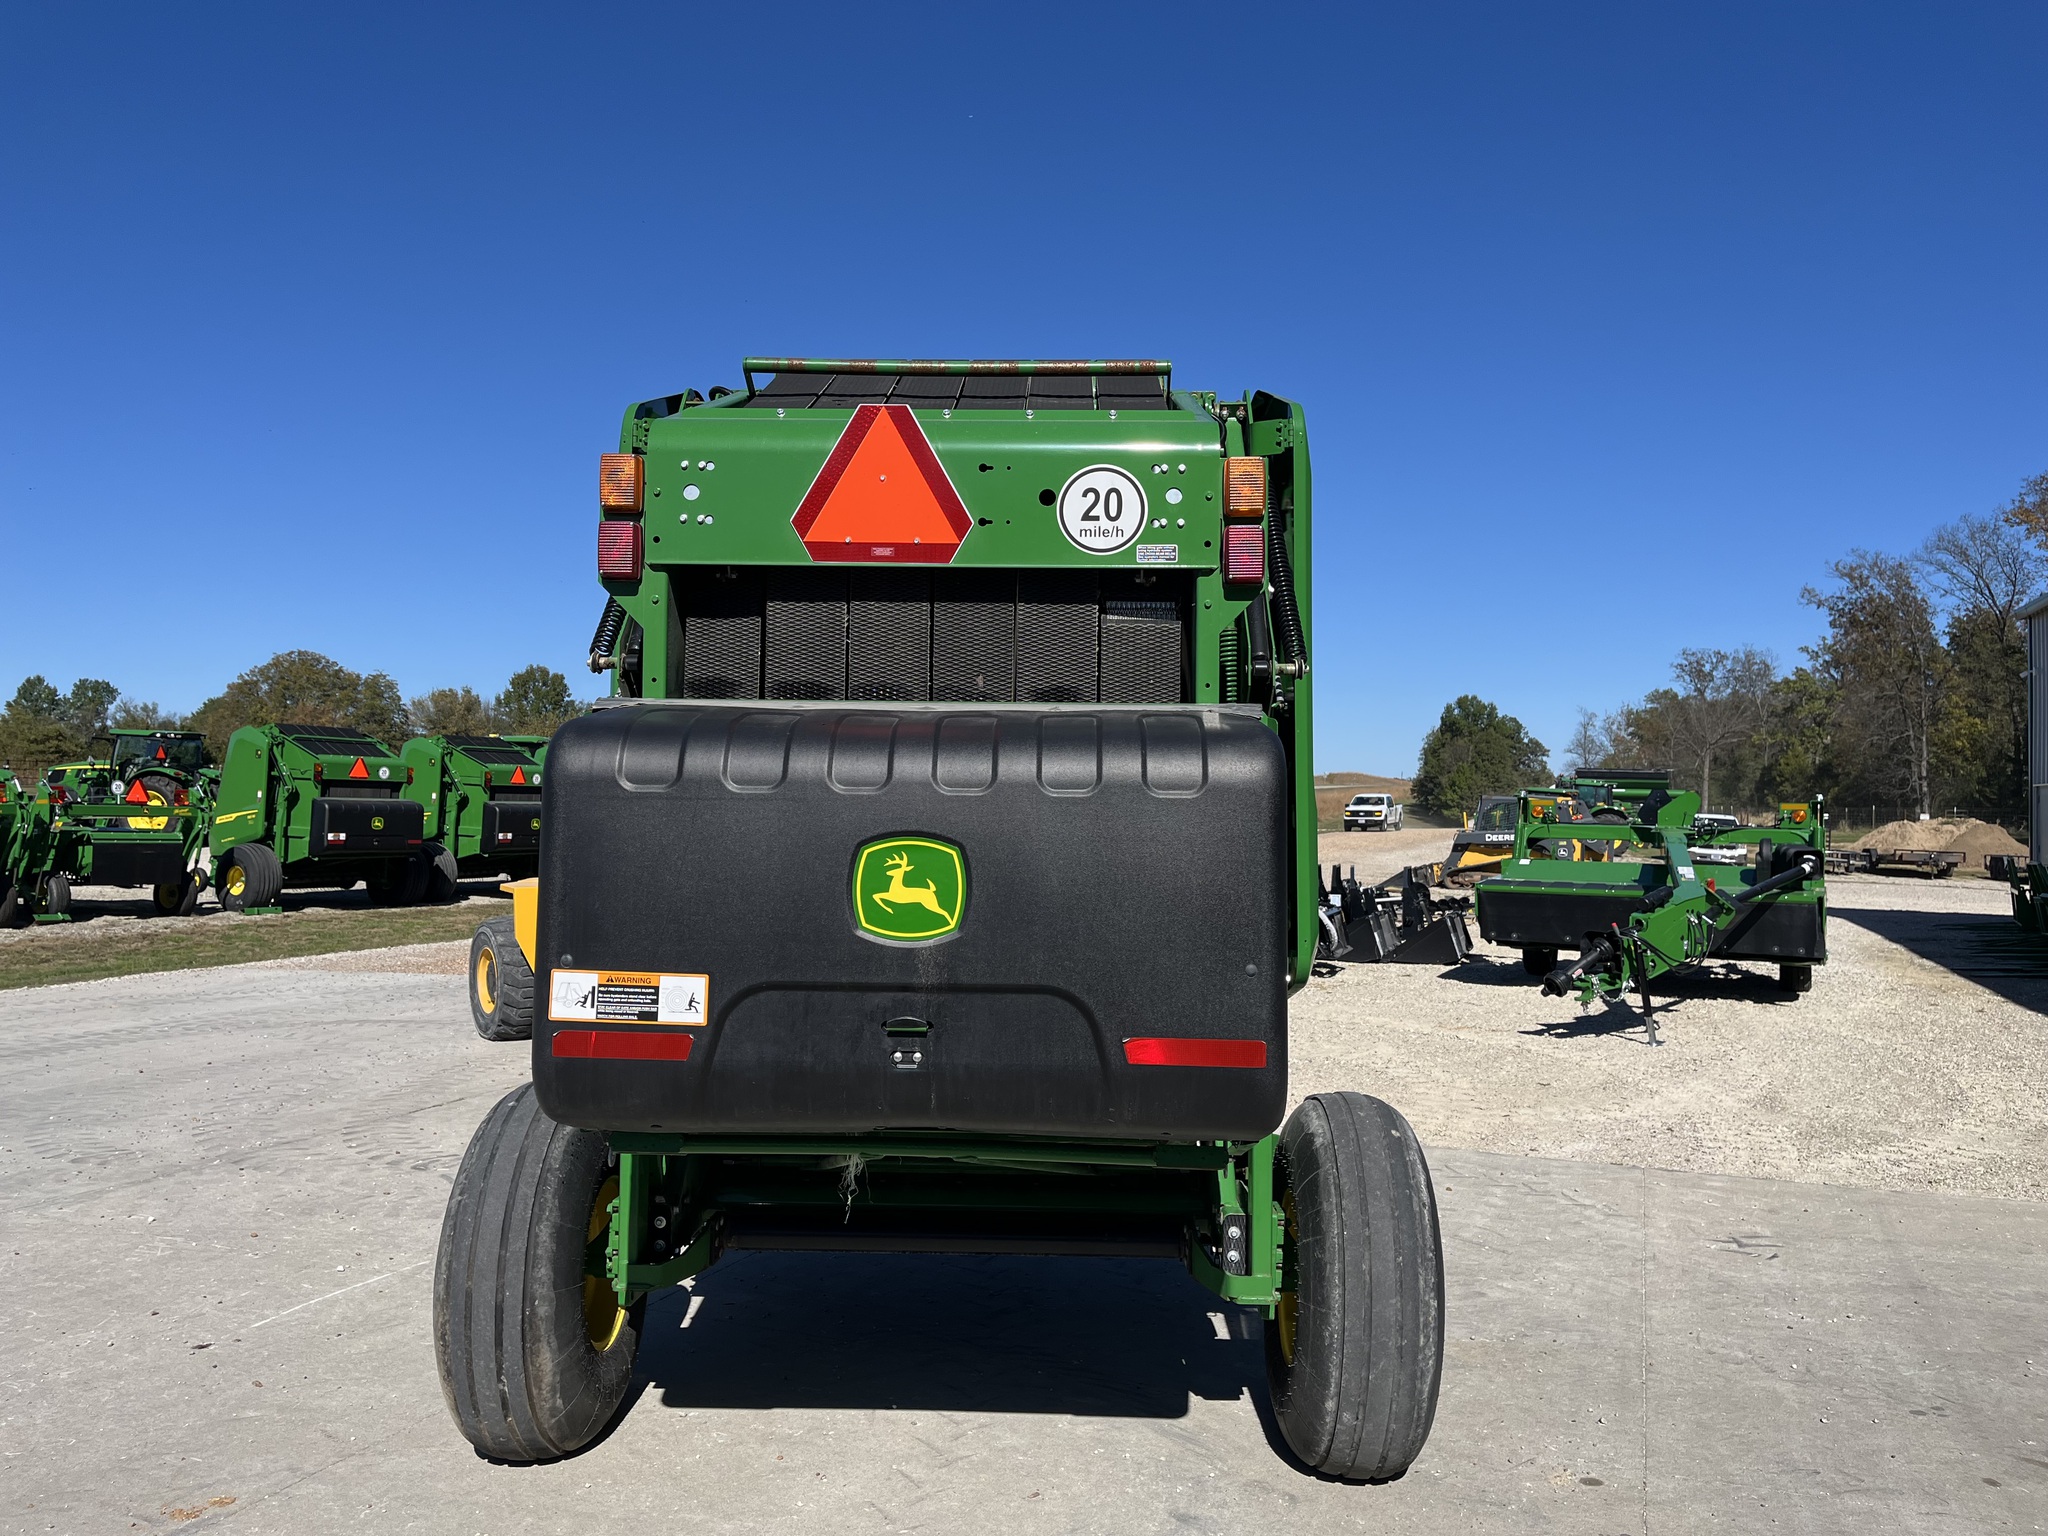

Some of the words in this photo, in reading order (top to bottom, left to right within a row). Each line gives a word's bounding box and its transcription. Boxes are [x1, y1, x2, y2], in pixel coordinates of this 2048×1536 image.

[1081, 487, 1123, 522] 20
[1080, 525, 1124, 538] mile/h
[1485, 833, 1515, 842] DEERE
[613, 976, 652, 985] WARNING
